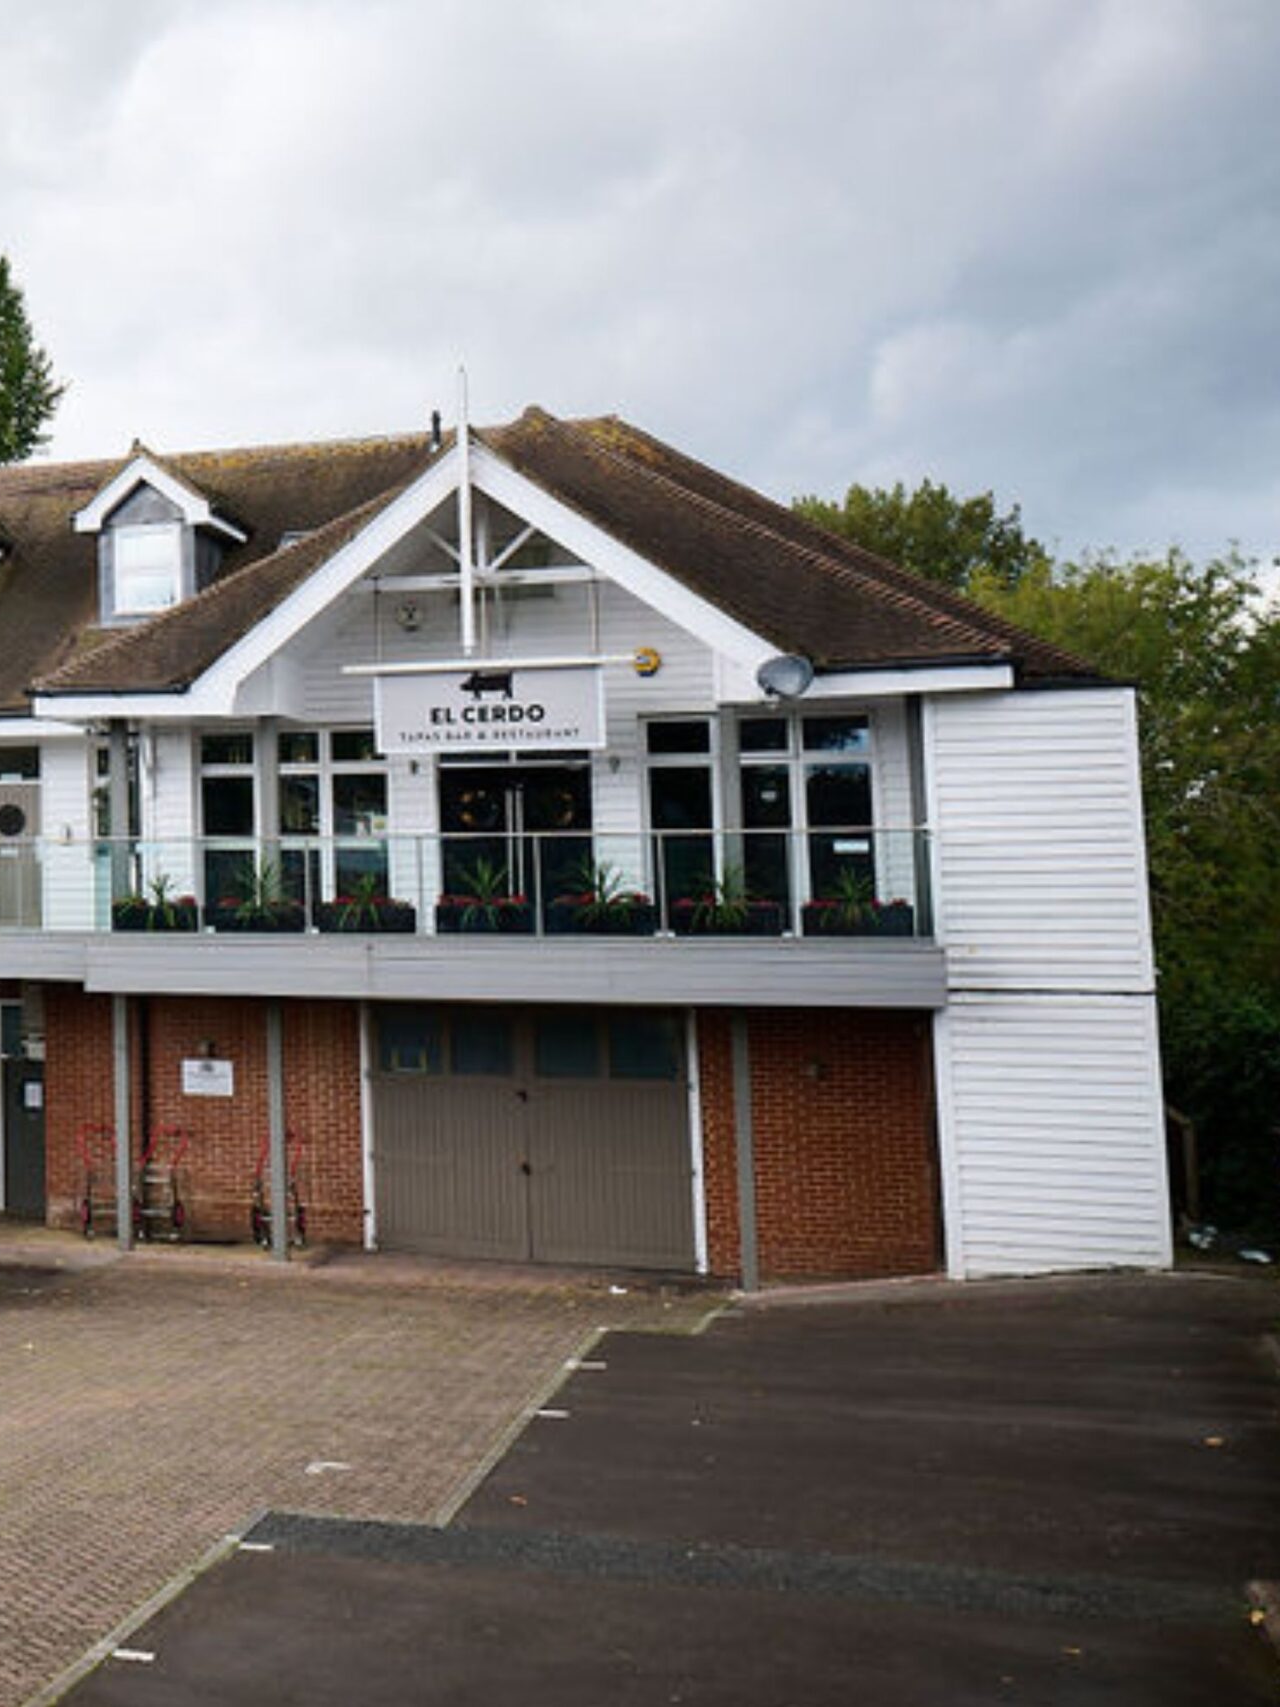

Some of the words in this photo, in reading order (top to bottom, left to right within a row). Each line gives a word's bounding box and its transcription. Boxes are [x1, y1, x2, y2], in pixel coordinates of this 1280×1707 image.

[430, 707, 457, 725] EL
[461, 704, 545, 723] CERDO
[399, 731, 441, 742] TAPAS
[446, 730, 472, 741] BAR
[492, 727, 579, 741] RESTAURANT
